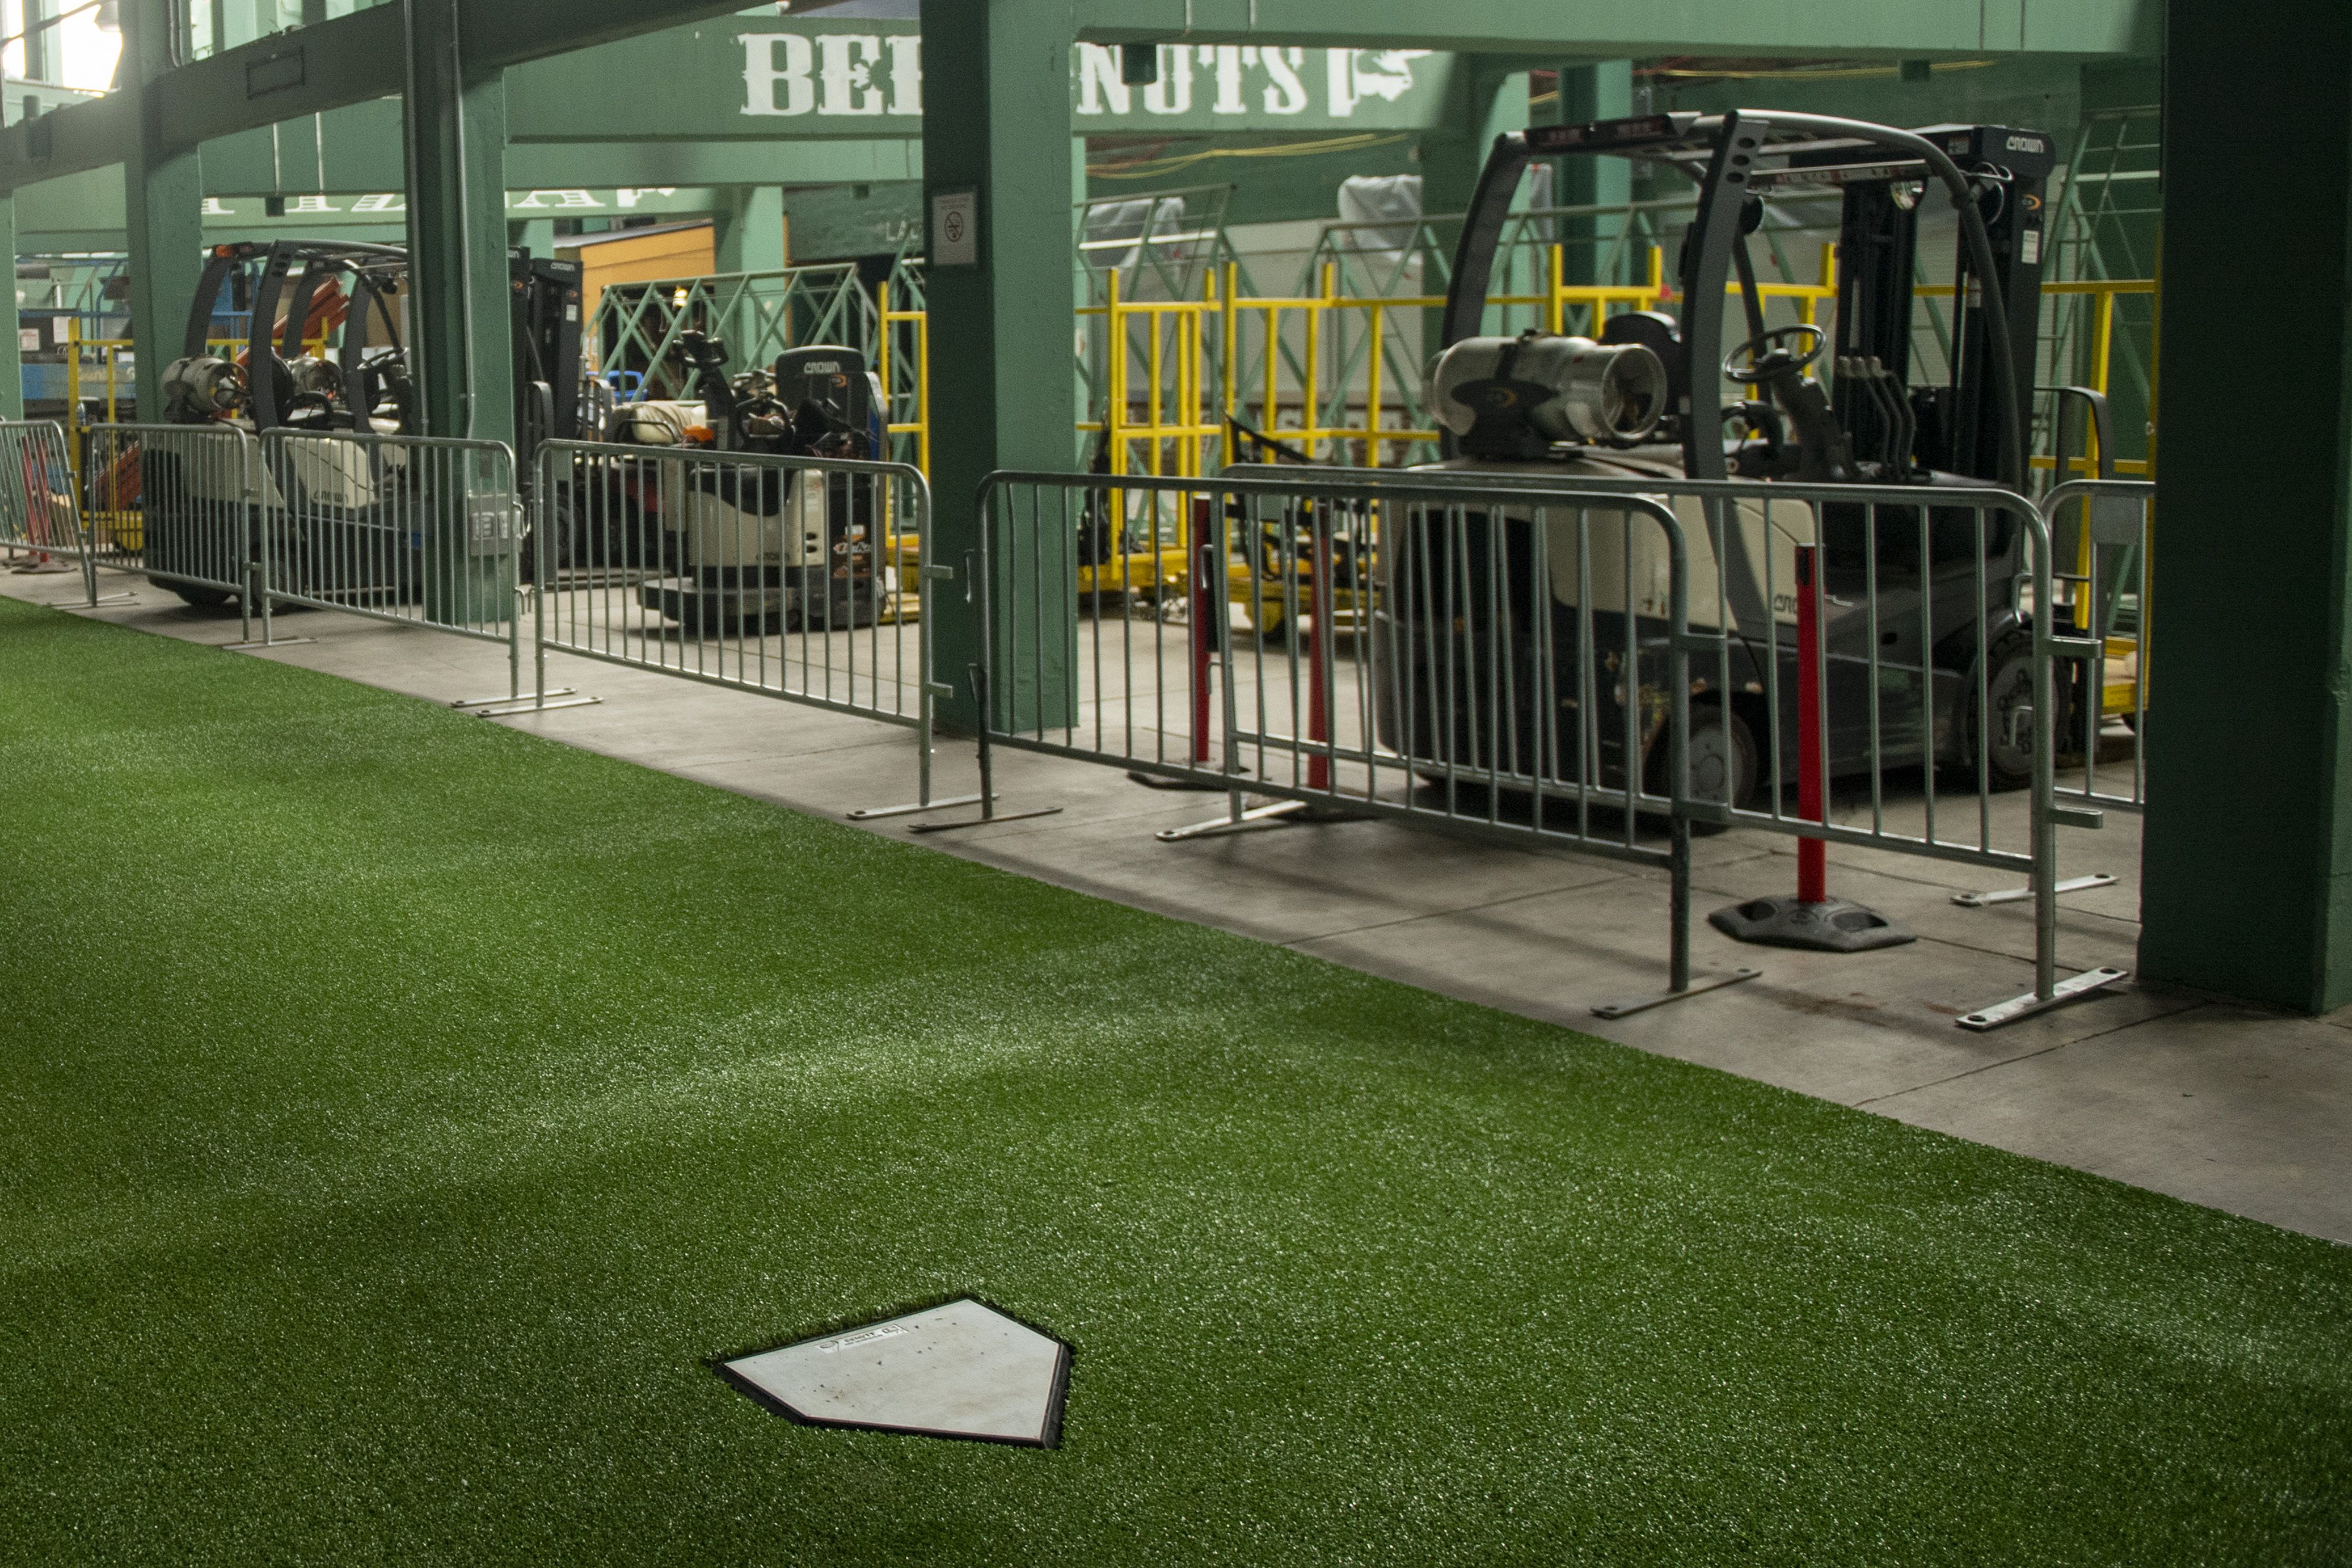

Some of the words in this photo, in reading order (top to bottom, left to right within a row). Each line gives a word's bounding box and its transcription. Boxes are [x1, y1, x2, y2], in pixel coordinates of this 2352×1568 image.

[1074, 42, 1307, 114] NUTS
[2006, 135, 2044, 153] CROWN
[804, 362, 840, 374] CROWN
